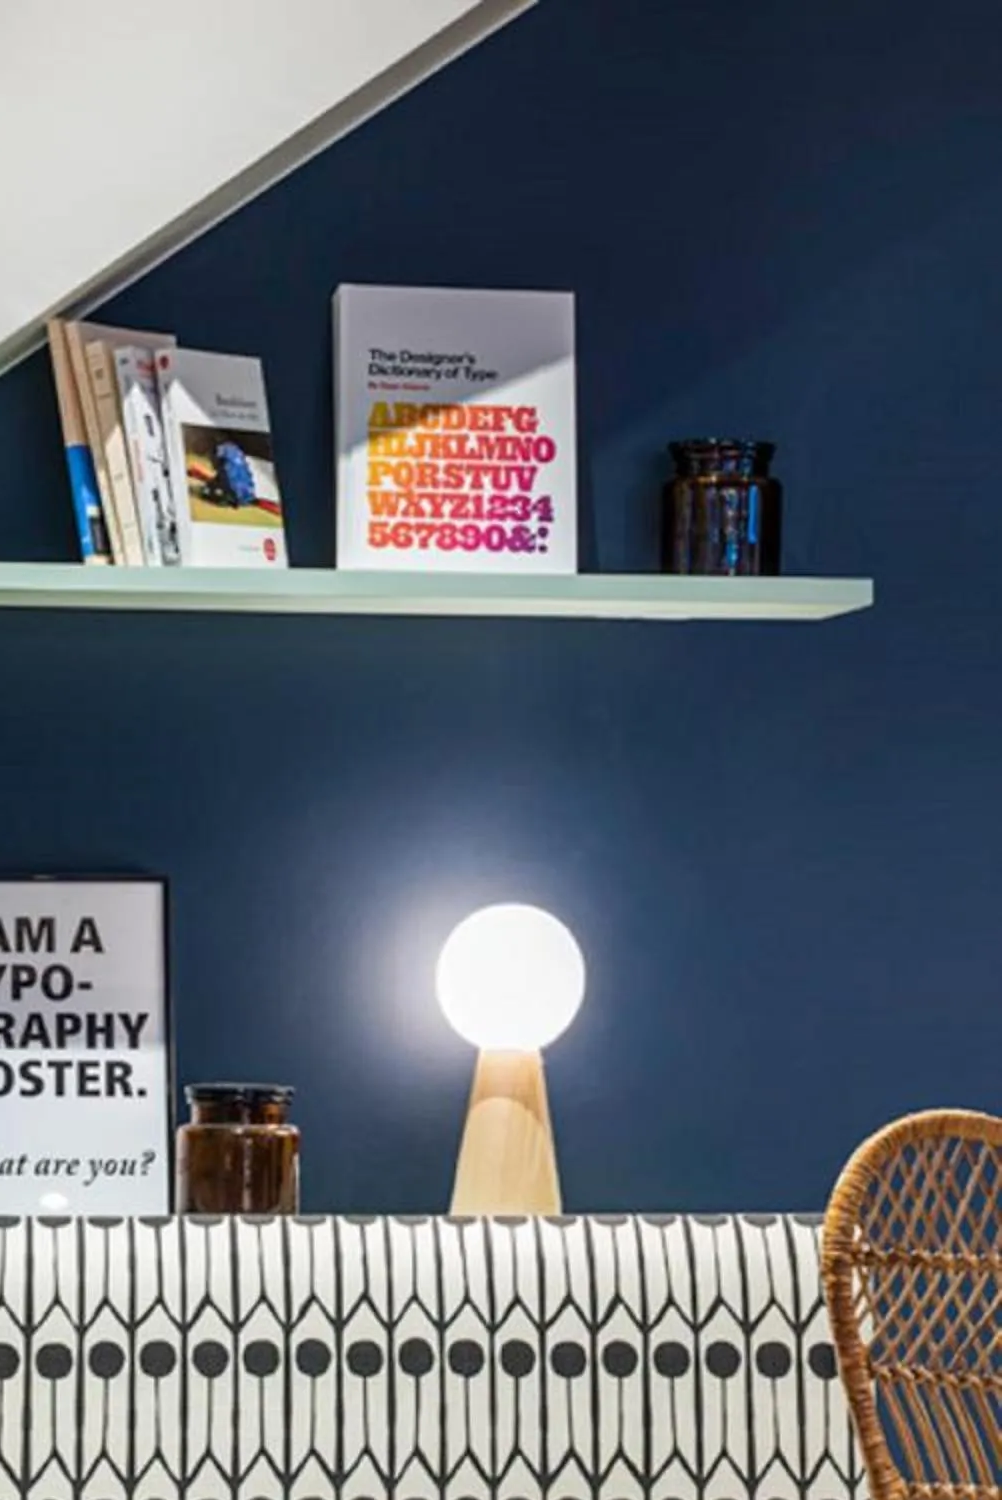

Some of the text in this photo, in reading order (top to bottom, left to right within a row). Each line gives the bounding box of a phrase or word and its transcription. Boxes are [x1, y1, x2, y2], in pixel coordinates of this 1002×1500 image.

[368, 348, 476, 366] The Designer's
[368, 363, 499, 382] Dictionary of Type
[368, 401, 539, 433] ABCDEFG
[368, 431, 556, 463] HIJKLMNO
[368, 461, 537, 492] PQRSTUV
[368, 490, 554, 522] WXYZ1234
[70, 916, 104, 952] A
[34, 1155, 78, 1176] are
[83, 1151, 155, 1186] you?
